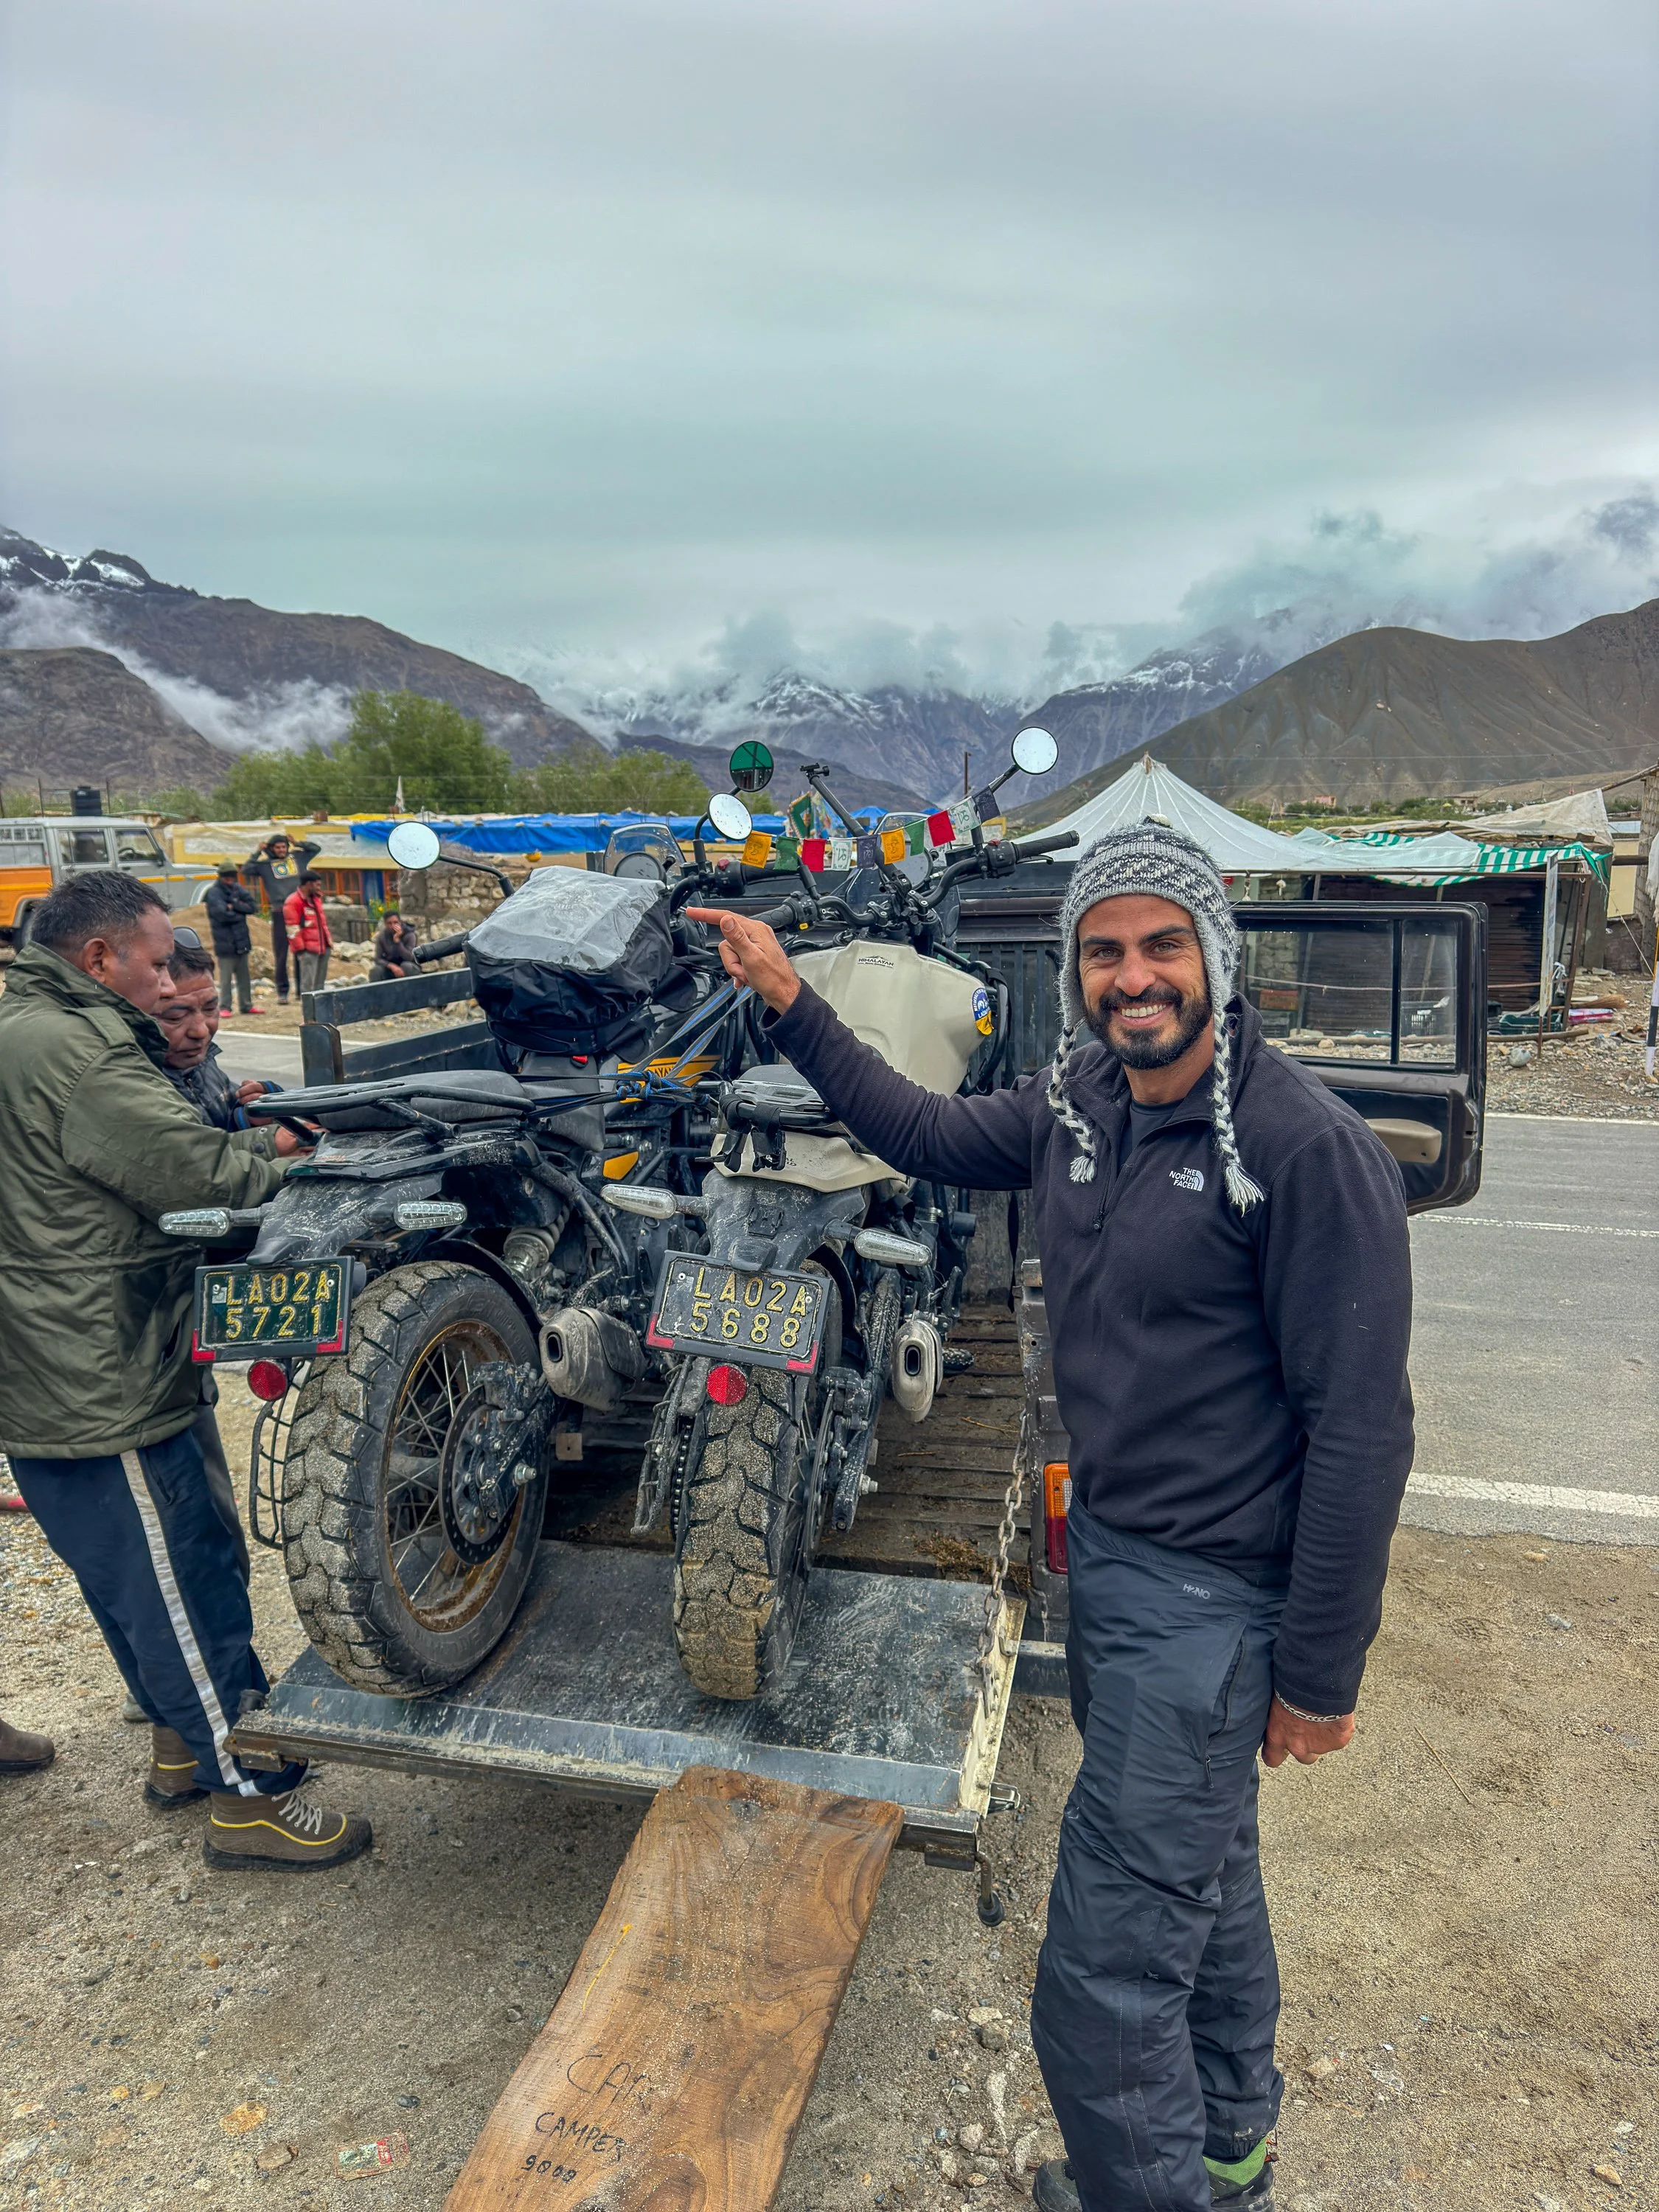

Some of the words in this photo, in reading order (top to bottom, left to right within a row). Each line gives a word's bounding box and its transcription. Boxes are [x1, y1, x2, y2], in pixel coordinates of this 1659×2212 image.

[858, 958, 894, 967] HIMALAYAN
[1169, 1170, 1195, 1183] NORTH
[1183, 1167, 1197, 1176] THE
[1173, 1179, 1192, 1189] FACE
[226, 1270, 330, 1306] LA02A
[694, 1266, 806, 1317] LA02A
[226, 1304, 321, 1340] 5721
[691, 1301, 801, 1349] 5688
